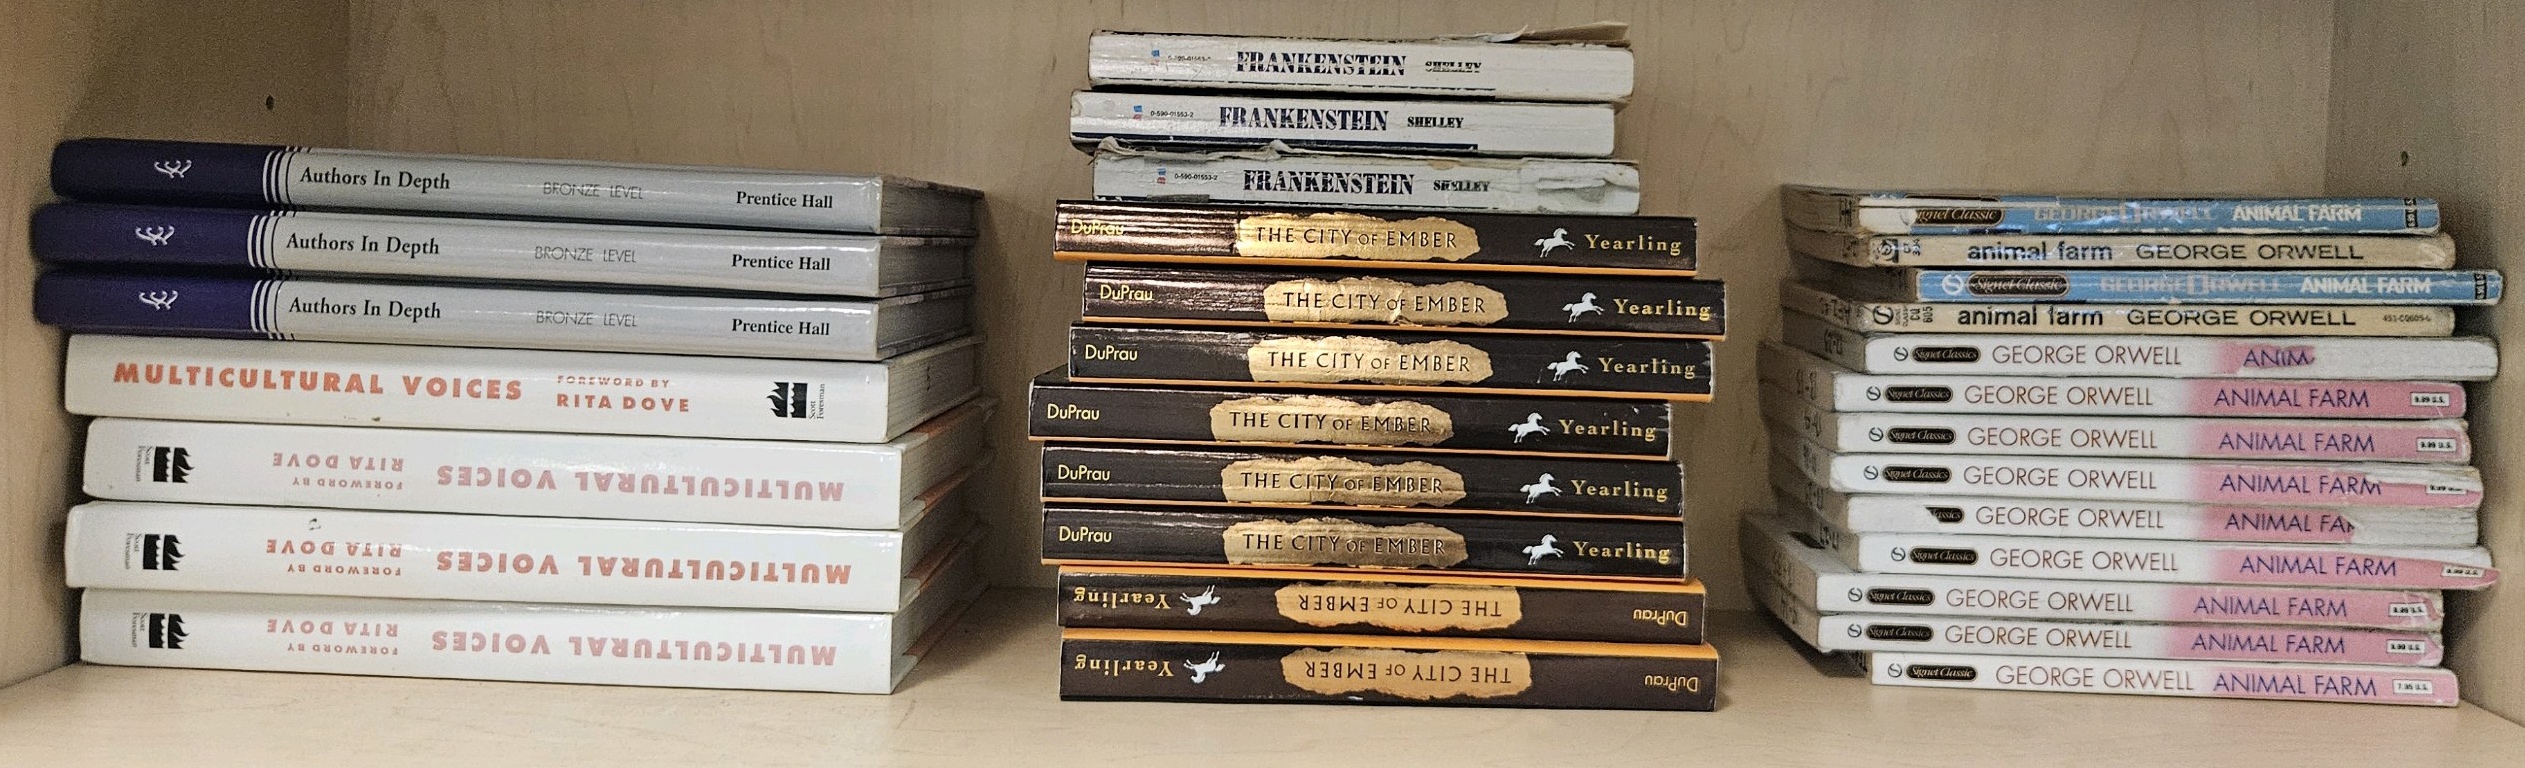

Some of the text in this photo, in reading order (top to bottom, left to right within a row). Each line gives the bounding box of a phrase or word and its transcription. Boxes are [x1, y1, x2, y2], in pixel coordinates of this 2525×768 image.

[1236, 51, 1406, 76] FRANKENSTEIN
[1219, 106, 1464, 131] FRANKENSTEIN SHELLEY
[301, 167, 450, 193] Authors In Depth
[1243, 170, 1490, 194] FRANKENSTEIN SHELLEY
[736, 190, 833, 209] Prentice Hall
[2232, 204, 2361, 222] ANIMAL FARM
[286, 232, 440, 258] Authors In Depth
[1257, 227, 1457, 248] THE CITY OF EMBER
[1584, 234, 1681, 256] Yearling
[534, 246, 636, 263] BRONZE LEVEL
[1968, 241, 2363, 261] animal farm GEORGE ORWELL
[731, 254, 831, 271] Prentice Hall
[1100, 284, 1154, 301] DuPrau
[2301, 277, 2431, 293] ANIMAL FARM
[289, 297, 441, 323] Authors In Depth
[1283, 292, 1485, 313] THE CITY OF EMBER
[1614, 298, 1711, 322] Yearling
[536, 310, 638, 327] BRONZE LEVEL
[1923, 306, 1933, 323] 605
[1958, 306, 2036, 325] animal
[2127, 310, 2238, 325] GEORGE
[2250, 310, 2355, 325] ORWELL
[731, 318, 830, 336] Prentice Hall
[1085, 345, 1138, 361] DuPrau
[1268, 351, 1470, 372] THE CITY OF EMBER
[1992, 345, 2181, 365] GEORGE ORWELL
[1598, 357, 1696, 380] Yearling
[114, 362, 522, 400] MULTICULTURAL VOICES
[557, 375, 670, 388] FOREWORD BY
[557, 394, 690, 413] RITA DOVE
[1964, 385, 2153, 406] GEORGE ORWELL
[2214, 389, 2369, 408] ANIMAL FARM
[1047, 404, 1099, 420] DuPrau
[1229, 411, 1431, 432] THE CITY OF EMBER
[1558, 419, 1656, 441] Yearling
[1968, 427, 2157, 448] GEORGE ORWELL
[2219, 433, 2375, 452] ANIMAL FARM
[272, 452, 404, 472] RITA DOVE
[1058, 464, 1110, 481] DuPrau
[293, 477, 403, 489] FOREWORD BY
[437, 465, 844, 501] MULTICULTURAL VOICES
[1240, 472, 1442, 493] THE CITY OF EMBER
[1964, 465, 2156, 489] GEORGE ORWELL
[2220, 474, 2381, 495] ANIMAL FARM
[1571, 480, 1668, 503] Yearling
[1976, 506, 2163, 529] GEORGE ORWELL
[2225, 513, 2311, 532] ANIMAL
[1059, 526, 1112, 543] DuPrau
[1243, 533, 1446, 555] THE CITY OF EMBER
[266, 539, 402, 558] RITA DOVE
[1573, 541, 1671, 563] Yearling
[287, 563, 401, 576] FOREWORD BY
[437, 550, 851, 585] MULTICULTURAL VOICES
[1990, 548, 2178, 571] GEORGE ORWELL
[2240, 556, 2397, 577] ANIMAL FARM
[1074, 587, 1171, 609] Yearling
[1298, 594, 1502, 617] THE CITY OF EMBER
[1946, 588, 2133, 612] GEORGE ORWELL
[2193, 597, 2347, 617] ANIMAL FARM
[267, 618, 398, 637] RITA DOVE
[1633, 609, 1687, 626] DuPrau
[1945, 625, 2131, 648] GEORGE ORWELL
[2191, 633, 2345, 653] ANIMAL FARM
[432, 630, 836, 666] MULTICULTURAL VOICES
[1074, 655, 1174, 677] Yearling
[1306, 661, 1511, 684] THE CITY OF EMBER
[1911, 666, 1971, 678] Signet Classic
[1644, 674, 1699, 692] DuPrau
[1996, 665, 2194, 691] GEORGE ORWELL
[2214, 673, 2377, 697] ANIMAL FARM
